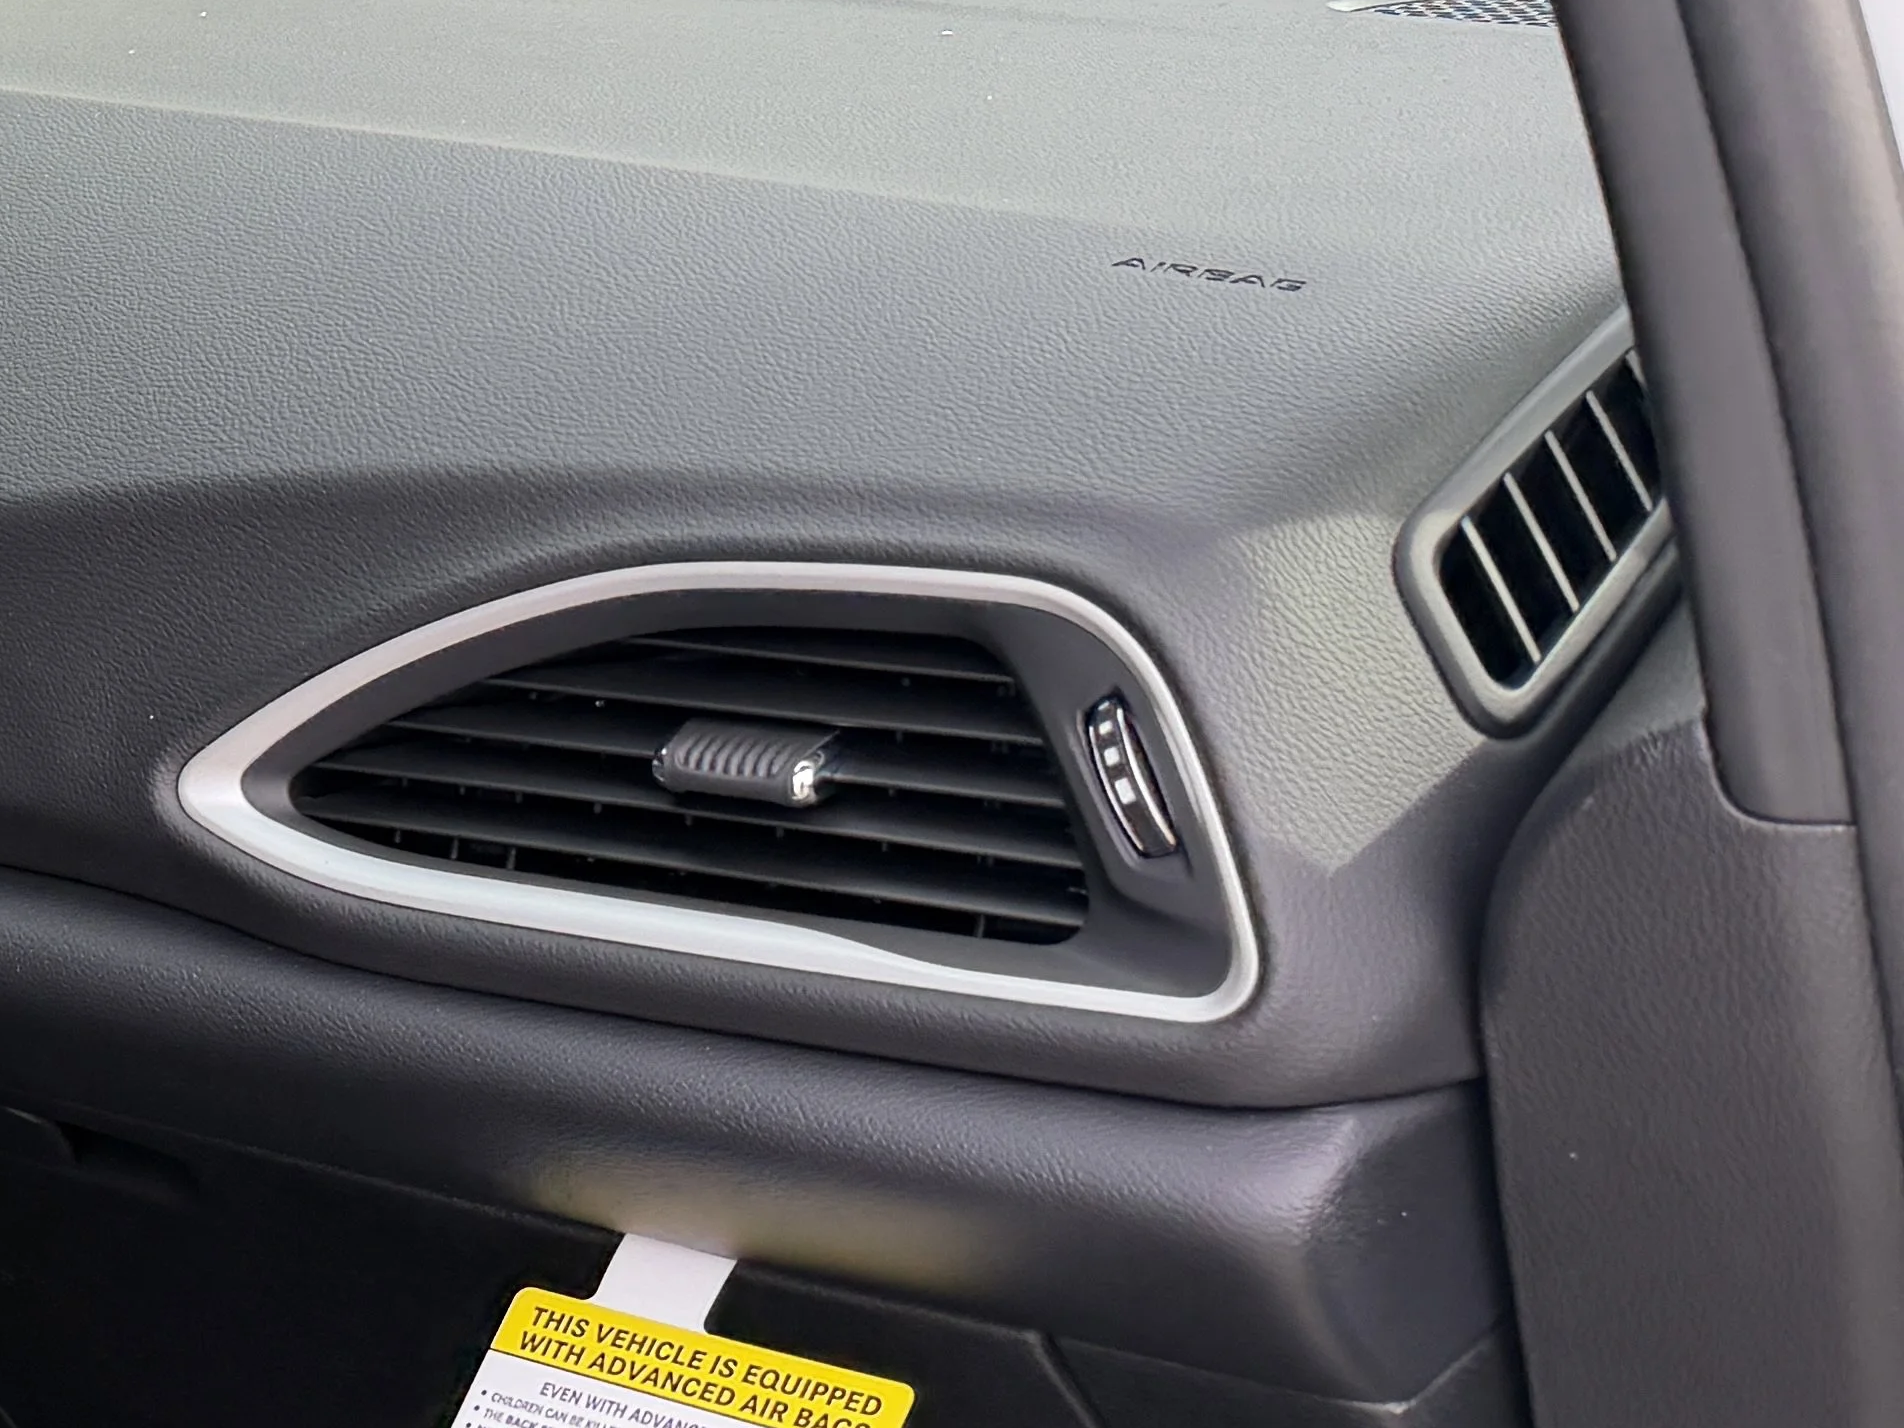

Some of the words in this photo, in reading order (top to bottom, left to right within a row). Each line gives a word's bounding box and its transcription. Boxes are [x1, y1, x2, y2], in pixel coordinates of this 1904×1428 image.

[1111, 257, 1307, 292] AIRBAG
[520, 1331, 586, 1366] WITH
[588, 1353, 735, 1406] ADVANCED
[739, 1394, 789, 1423] AIR
[532, 1306, 590, 1338] THIS
[597, 1323, 707, 1370] VEHICLE
[709, 1355, 738, 1378] IS
[742, 1364, 882, 1416] EQUIPPED
[483, 1407, 505, 1423] THE
[491, 1392, 544, 1415] CHILDREN
[544, 1407, 569, 1423] CAN
[568, 1414, 585, 1428] BE
[539, 1382, 583, 1405] EVEN
[585, 1394, 628, 1419] WITH
